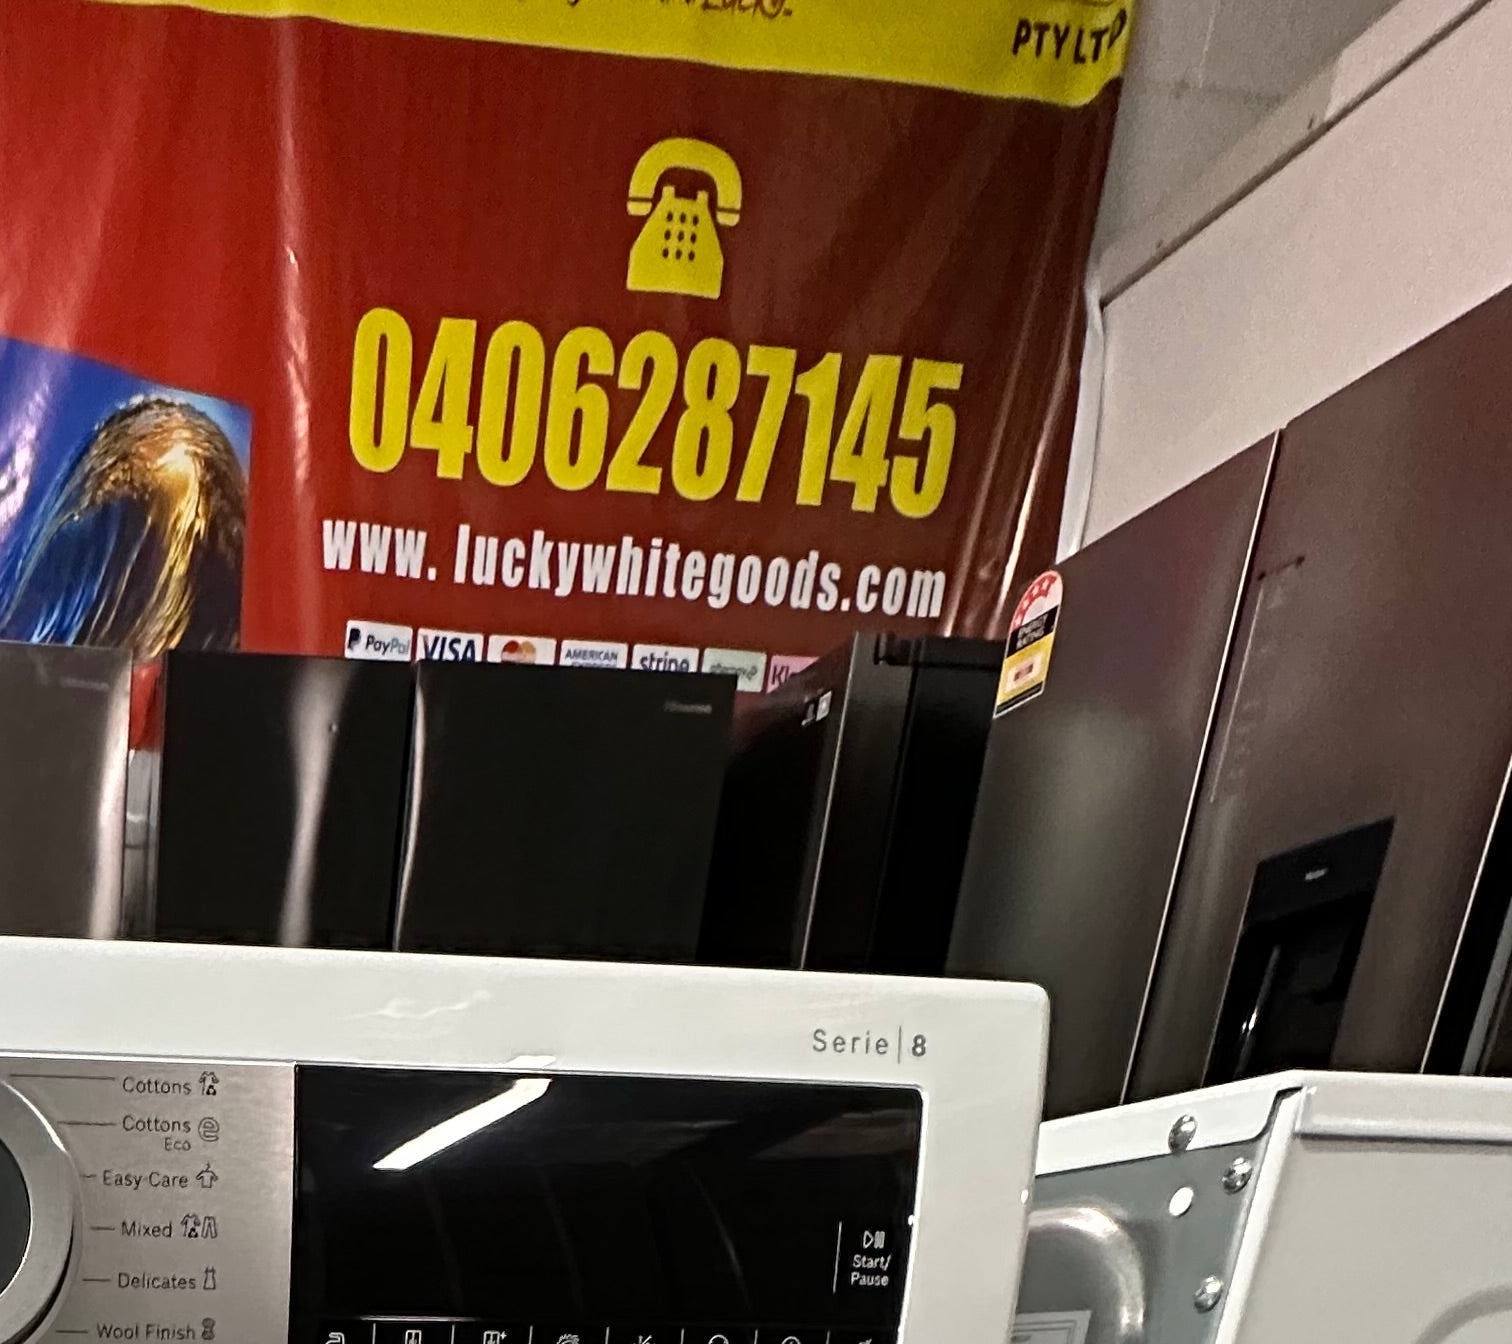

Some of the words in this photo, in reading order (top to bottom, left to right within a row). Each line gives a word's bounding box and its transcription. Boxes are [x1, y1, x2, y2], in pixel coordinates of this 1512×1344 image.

[1011, 18, 1071, 60] PTY
[348, 307, 964, 519] 0406287145
[321, 518, 437, 582] www.
[453, 523, 947, 619] luckywhitegoods.com
[365, 634, 411, 655] PayPal
[421, 635, 477, 663] VISA
[565, 648, 619, 661] AMERICAN
[122, 1076, 192, 1095] Cottons
[122, 1114, 192, 1133] Cottons
[164, 1137, 192, 1151] Eco
[103, 1169, 143, 1190] Easy
[148, 1171, 188, 1188] Care
[121, 1220, 173, 1238] Mixed
[852, 1253, 892, 1271] Start/
[117, 1272, 196, 1290] Delicates
[850, 1271, 889, 1287] Pause
[97, 1323, 138, 1341] Wool
[145, 1323, 196, 1341] Finish
